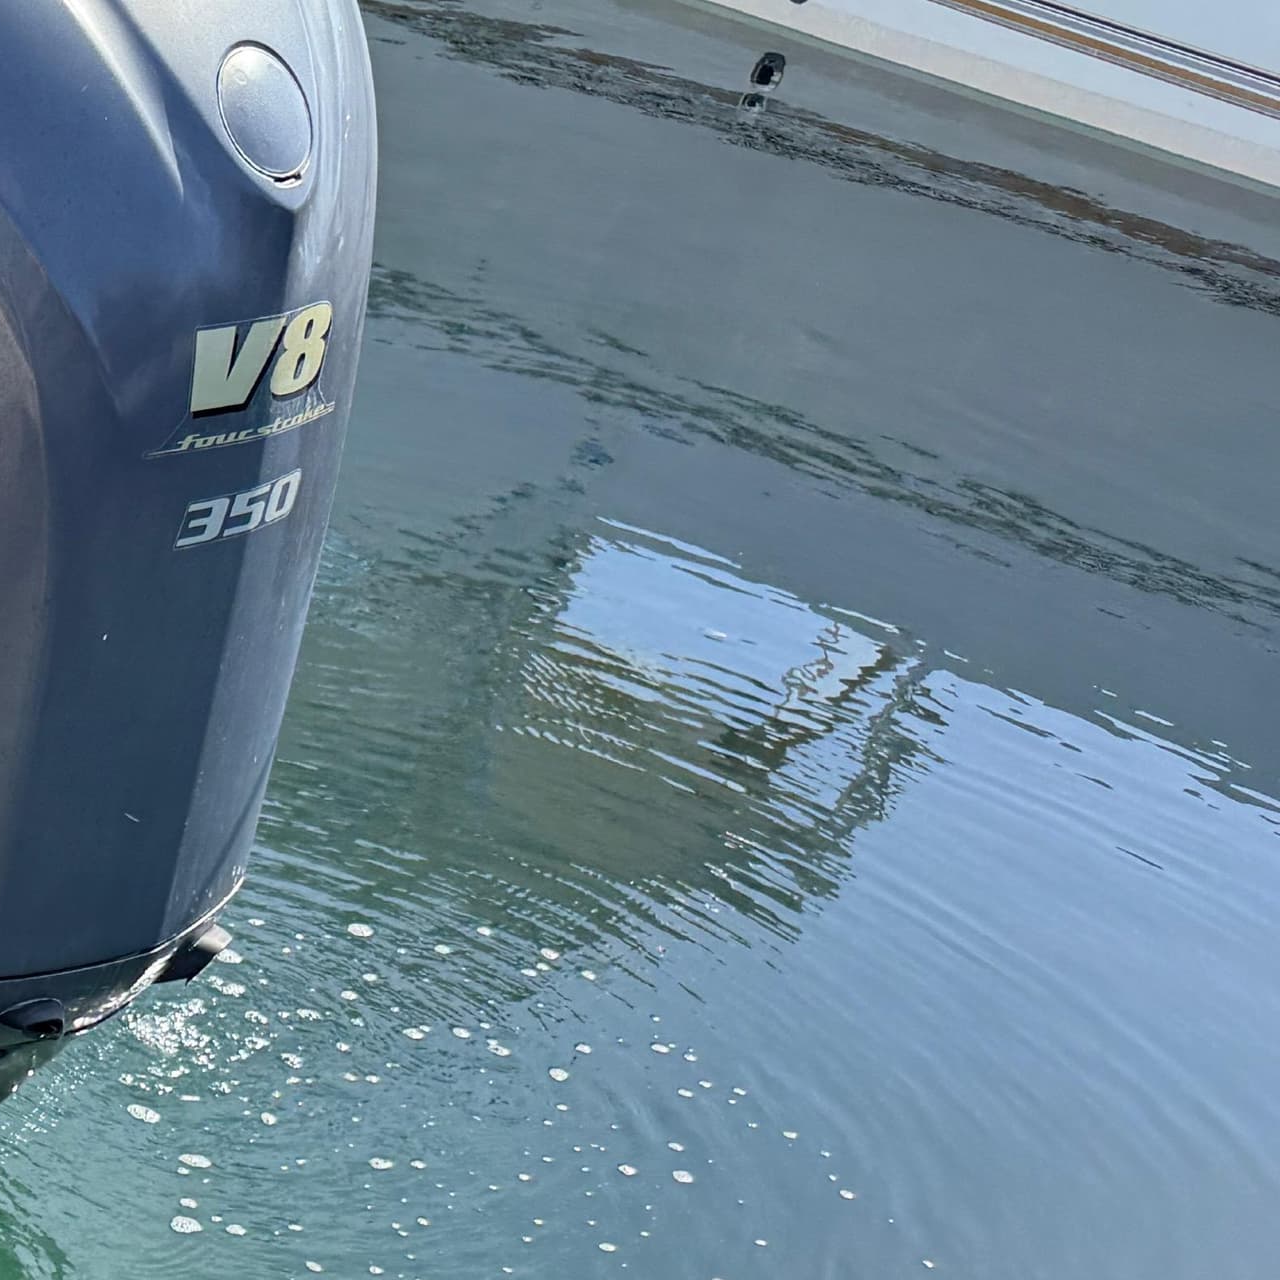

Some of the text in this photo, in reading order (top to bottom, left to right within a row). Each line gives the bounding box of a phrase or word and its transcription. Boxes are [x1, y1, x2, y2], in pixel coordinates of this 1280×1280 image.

[190, 302, 333, 418] V8
[176, 403, 327, 450] four stroke
[175, 470, 302, 548] 350
